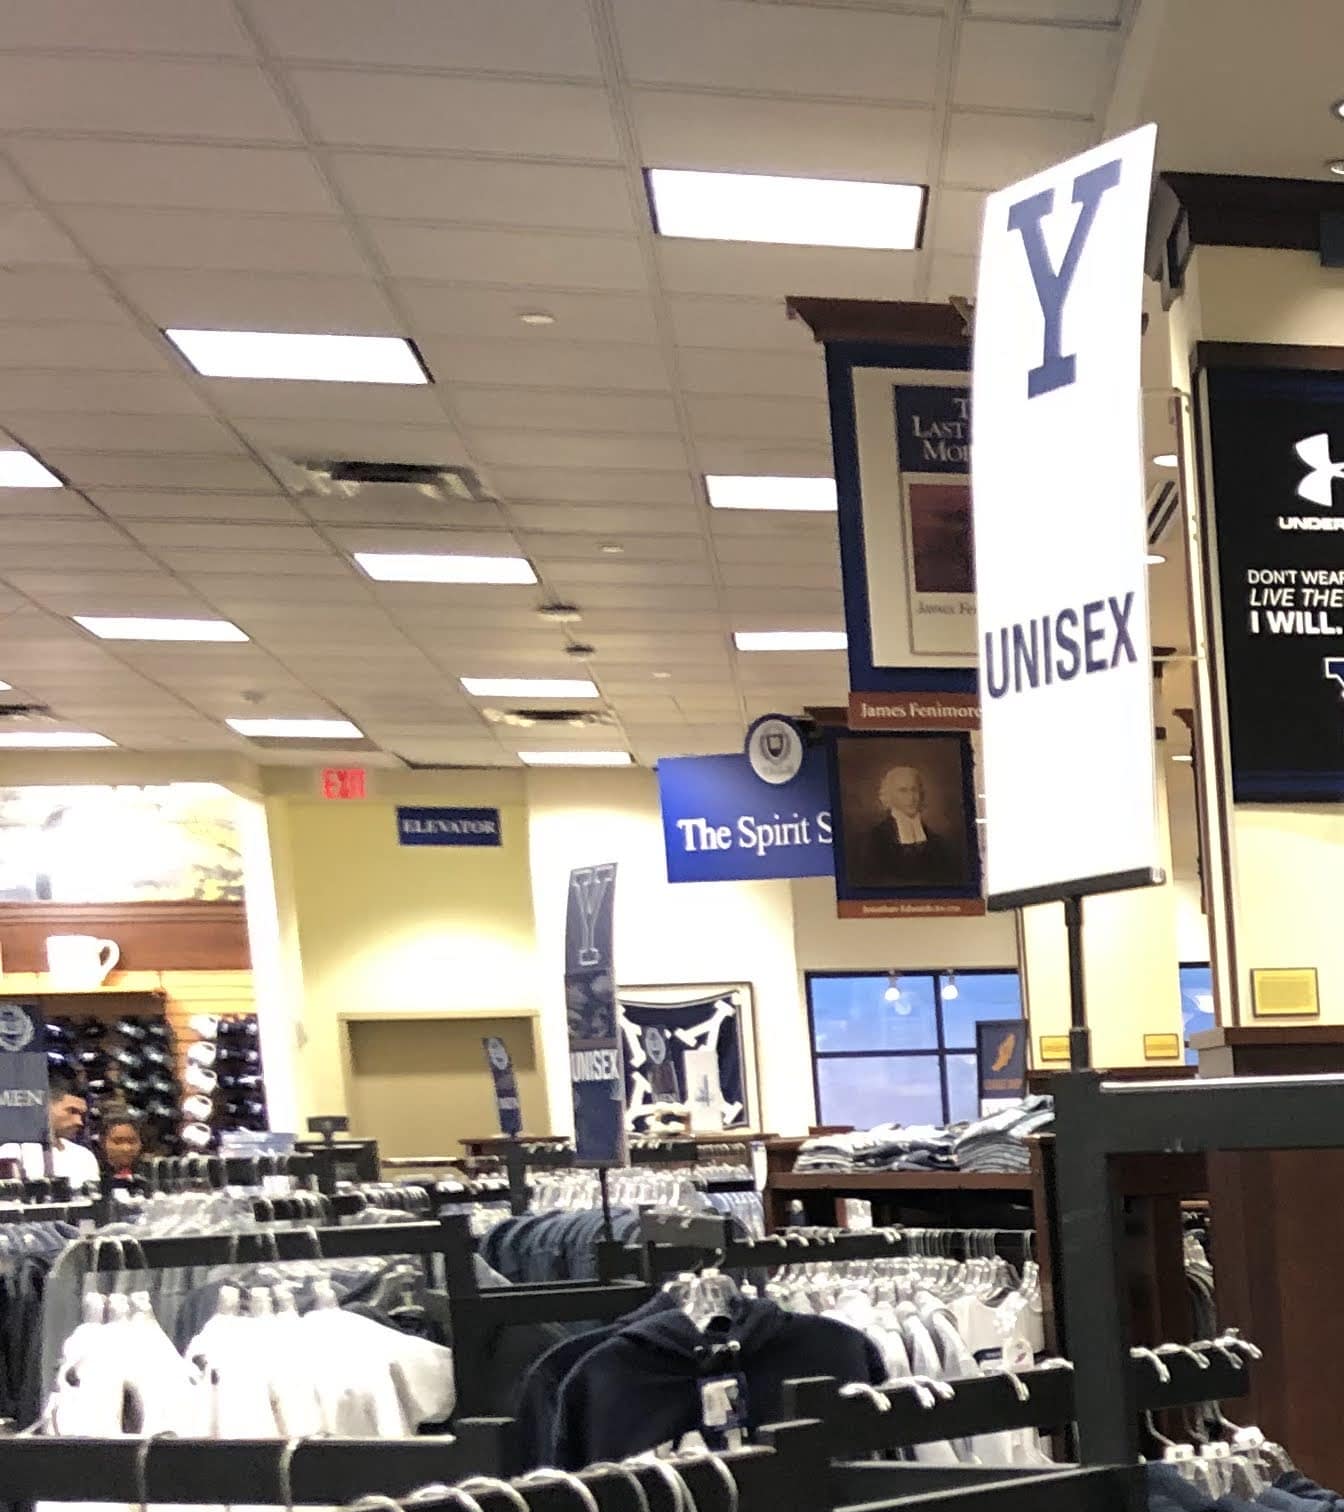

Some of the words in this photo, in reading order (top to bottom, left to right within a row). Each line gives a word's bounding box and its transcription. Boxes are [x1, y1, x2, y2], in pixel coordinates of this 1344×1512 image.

[1007, 157, 1122, 400] Y
[1248, 569, 1297, 585] DON'T
[1250, 588, 1295, 607] LIVE
[1250, 610, 1259, 633] I
[1266, 611, 1343, 634] WILL.
[985, 591, 1137, 698] UNISEX
[860, 703, 907, 718] James
[402, 818, 496, 834] ELEVATOR
[676, 818, 732, 851] The
[738, 813, 811, 856] Spirit
[570, 1050, 620, 1081] UNISEX
